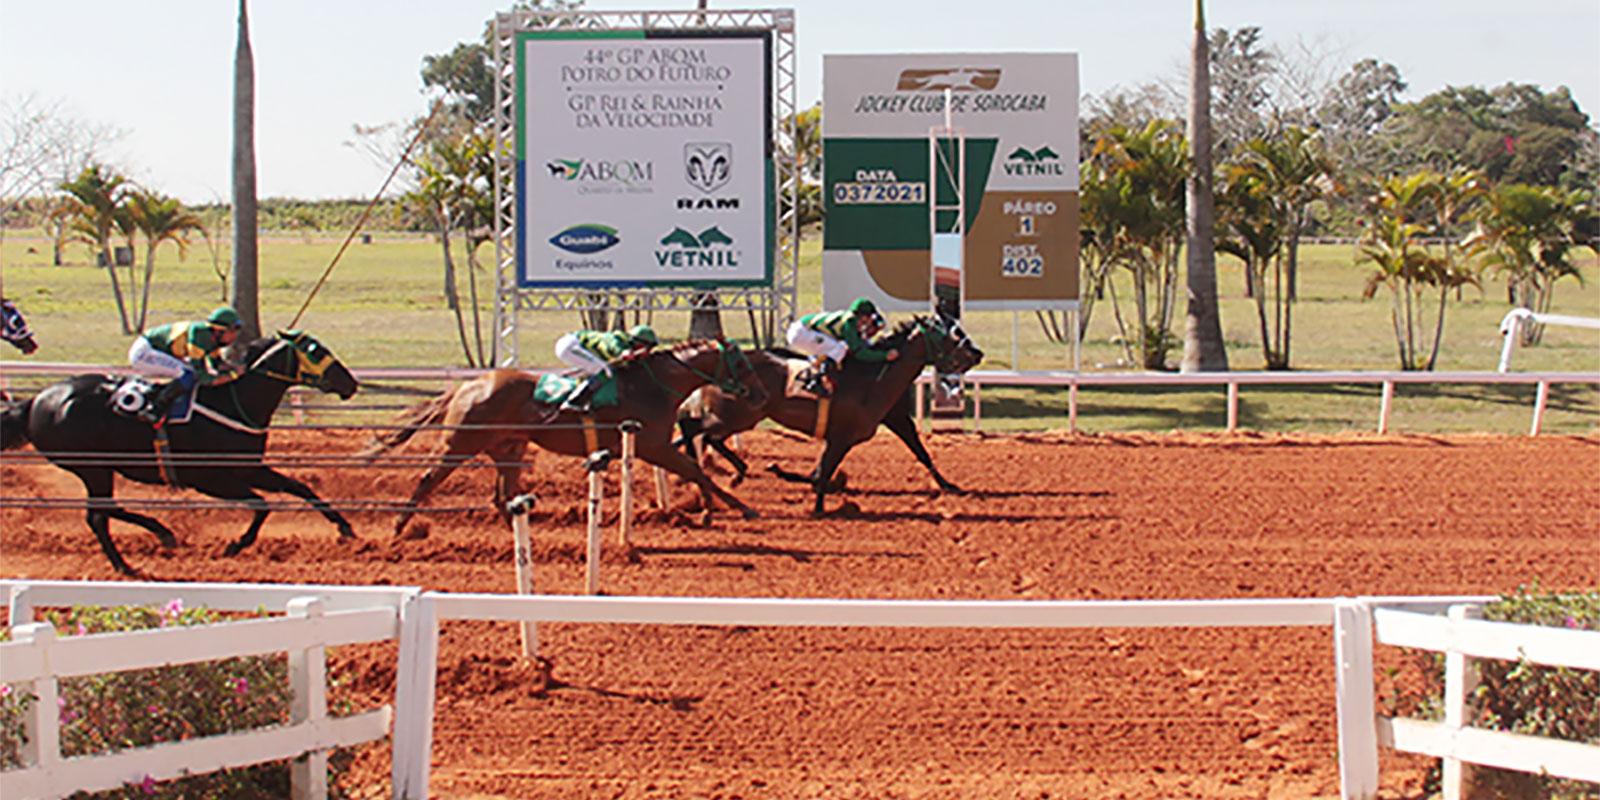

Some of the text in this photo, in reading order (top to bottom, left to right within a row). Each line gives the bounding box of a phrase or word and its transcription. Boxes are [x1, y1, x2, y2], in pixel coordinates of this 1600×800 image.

[617, 48, 645, 64] GP
[649, 48, 706, 66] ABQM
[626, 67, 655, 82] DO
[659, 66, 731, 82] FUTURO
[568, 95, 597, 111] GP
[631, 95, 646, 111] &
[652, 95, 722, 111] RAINHA
[855, 94, 908, 113] JOCKEY
[909, 94, 946, 112] CLUB
[973, 94, 1047, 113] SOROCABA
[576, 113, 714, 128] DA VELOCIDADE
[579, 159, 654, 183] ABQM
[856, 170, 896, 182] DATA
[1003, 163, 1063, 175] VETNIL
[676, 198, 739, 209] RAM
[1003, 200, 1056, 215] PÁREO
[1022, 218, 1033, 231] 1
[555, 259, 613, 271] Equinos
[655, 251, 738, 267] VETNIL
[1003, 259, 1042, 275] 402
